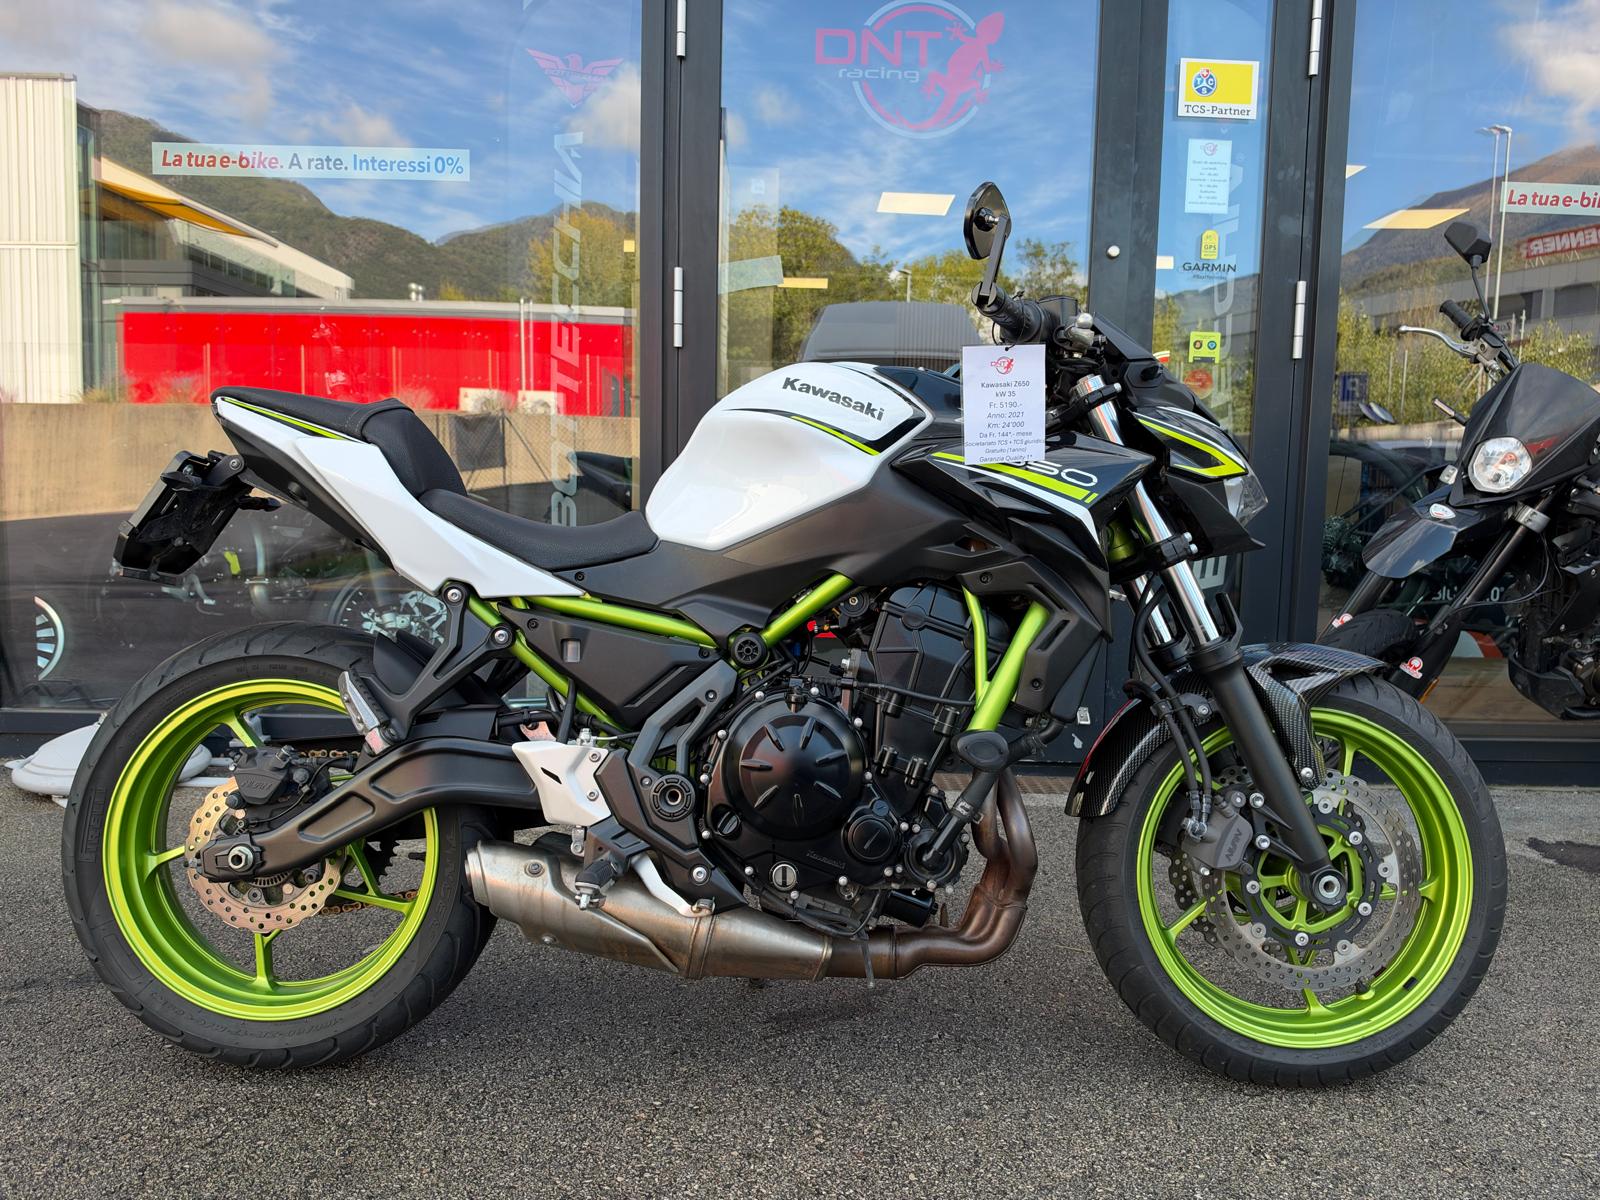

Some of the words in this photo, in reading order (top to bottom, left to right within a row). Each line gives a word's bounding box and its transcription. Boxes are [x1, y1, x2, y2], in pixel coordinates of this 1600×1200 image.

[815, 28, 943, 67] DNT
[838, 67, 920, 83] racing
[1184, 104, 1251, 116] TCS-Partner
[162, 150, 182, 167] La
[187, 152, 216, 168] tua
[219, 151, 283, 169] e-bike.
[288, 152, 302, 170] A
[307, 154, 348, 171] rate.
[353, 154, 431, 173] Interessi
[434, 156, 464, 175] 0%
[1507, 189, 1528, 206] La
[1531, 191, 1560, 207] tua
[1182, 262, 1237, 273] GARMIN
[782, 377, 885, 421] Kawasaki
[1010, 460, 1098, 487] 50
